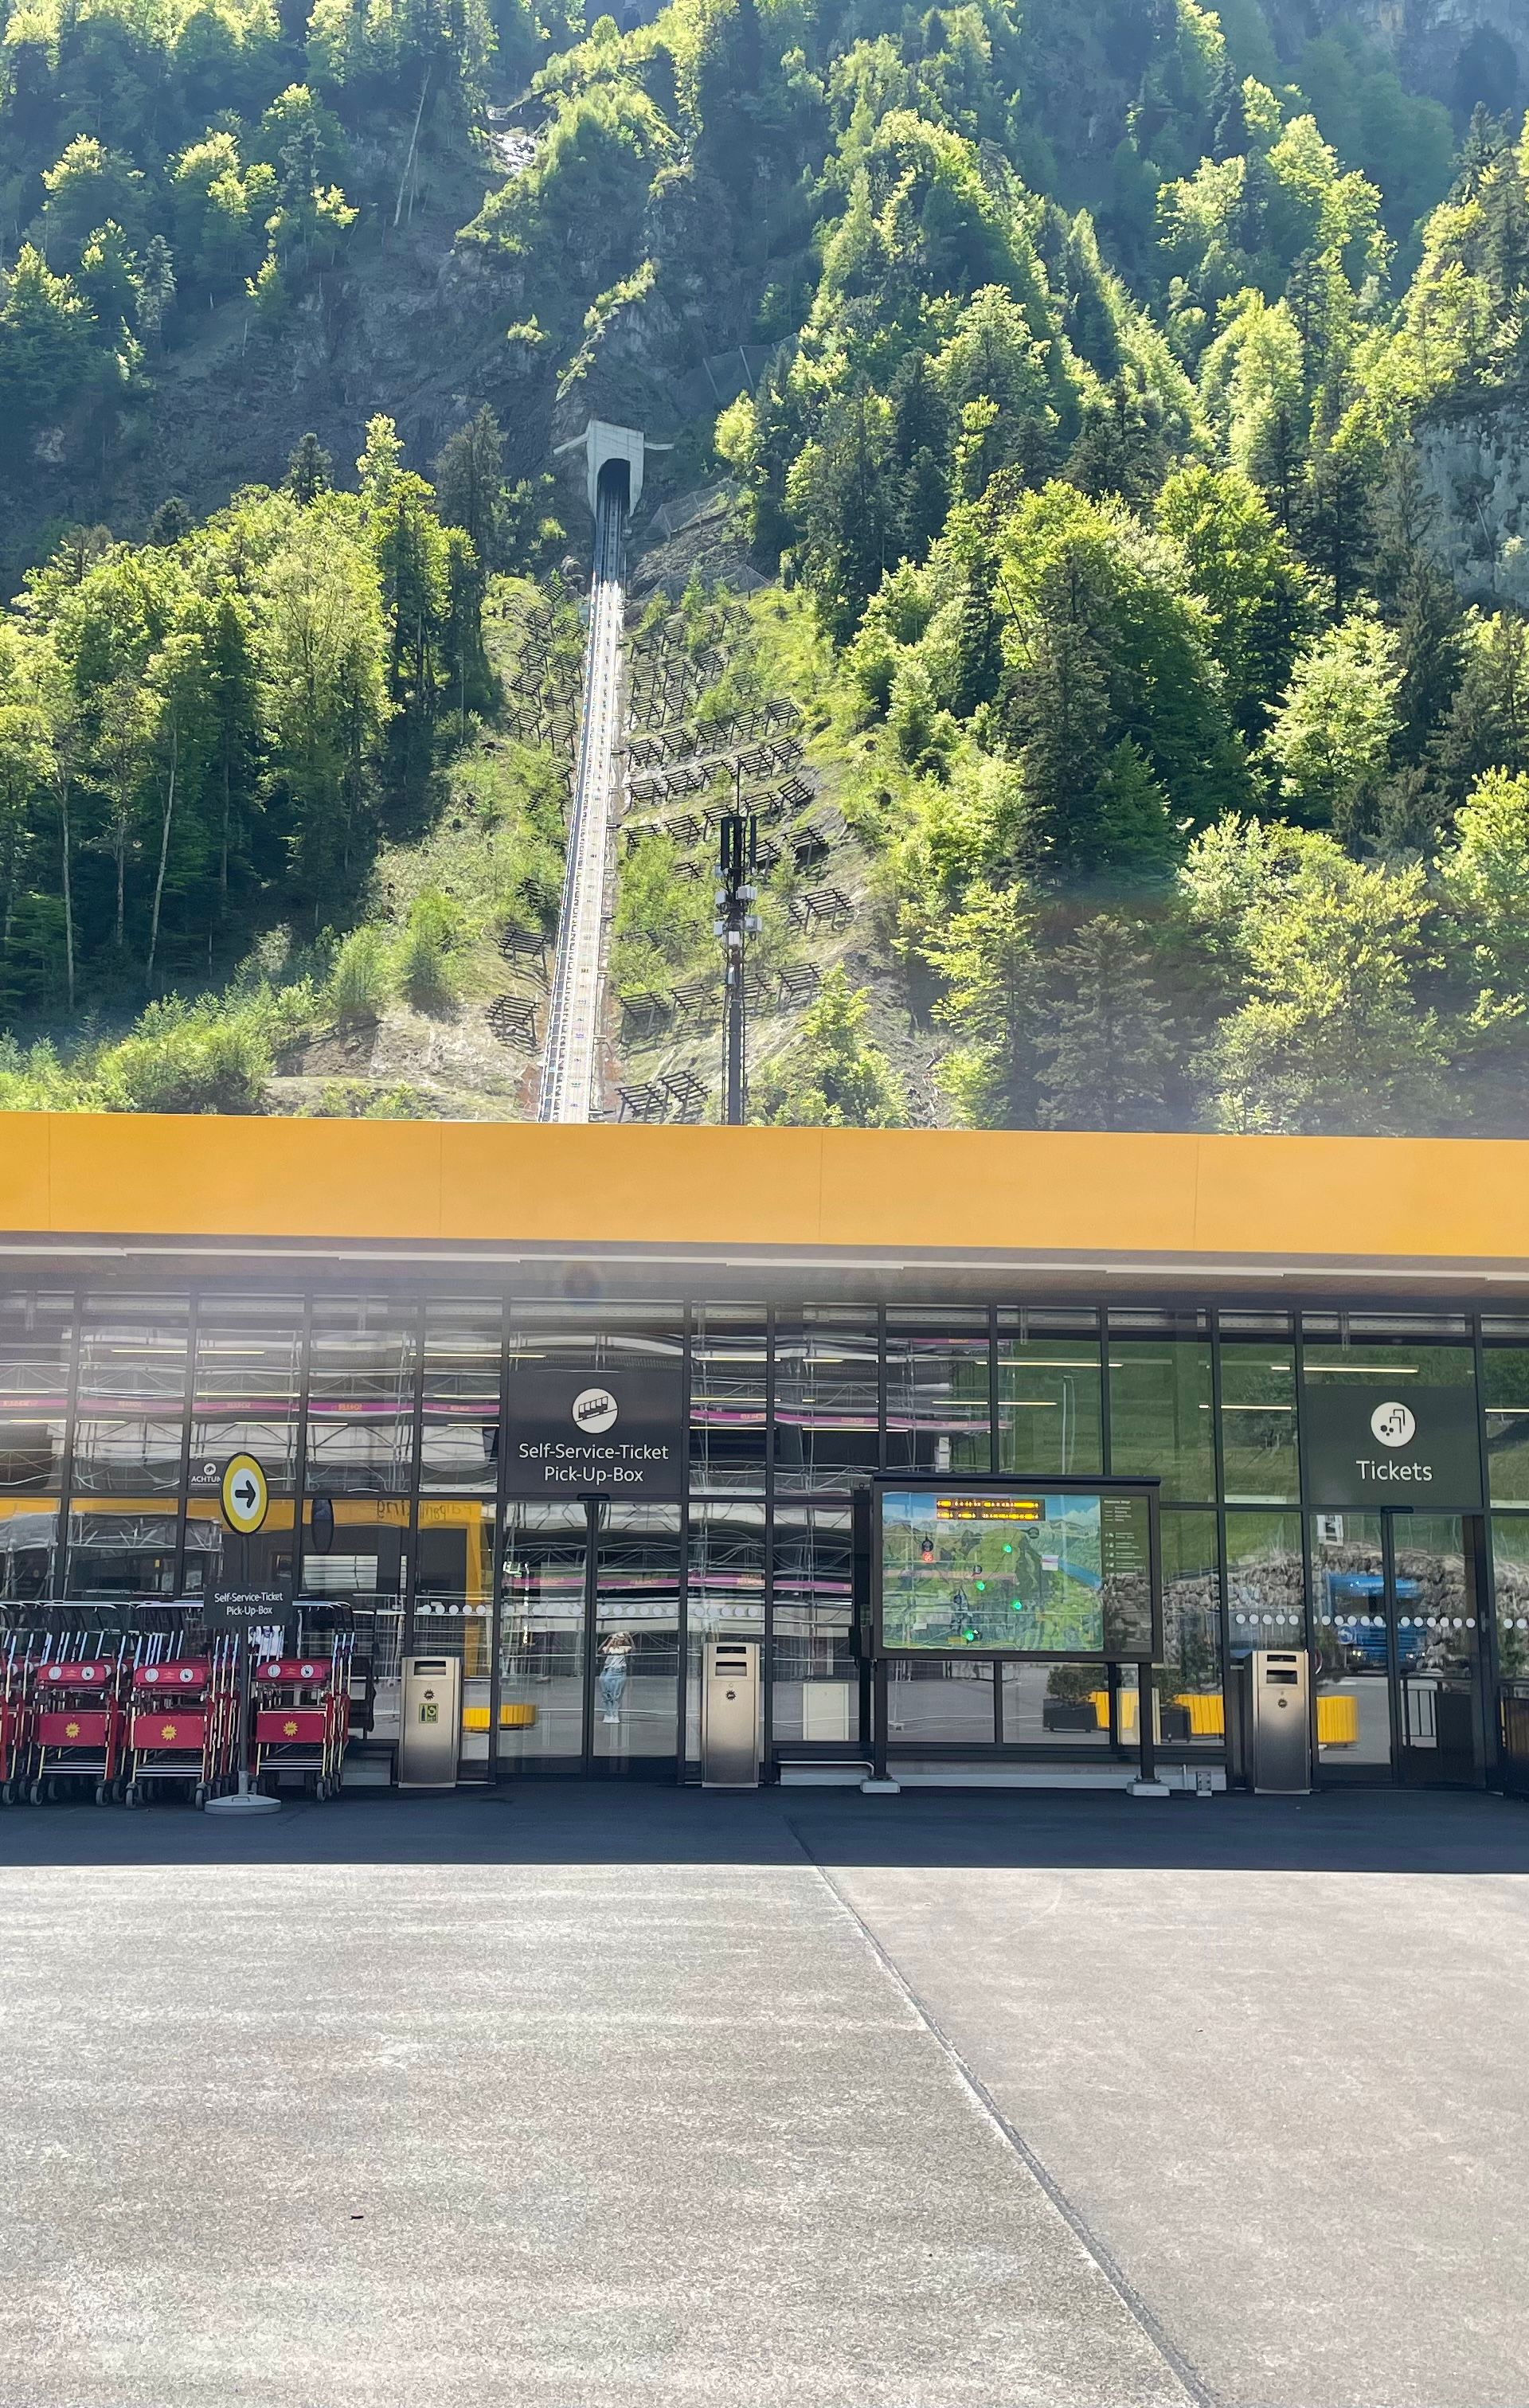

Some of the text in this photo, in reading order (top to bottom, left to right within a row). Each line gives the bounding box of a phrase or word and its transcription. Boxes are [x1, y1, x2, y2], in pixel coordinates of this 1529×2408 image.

[518, 1442, 669, 1460] Self-Service-Ticket
[544, 1466, 643, 1486] Pick-Up-Box
[1355, 1460, 1433, 1481] Tickets
[214, 1592, 284, 1603] Self-Service-Ticket
[226, 1605, 273, 1617] Pick-Up-Box
